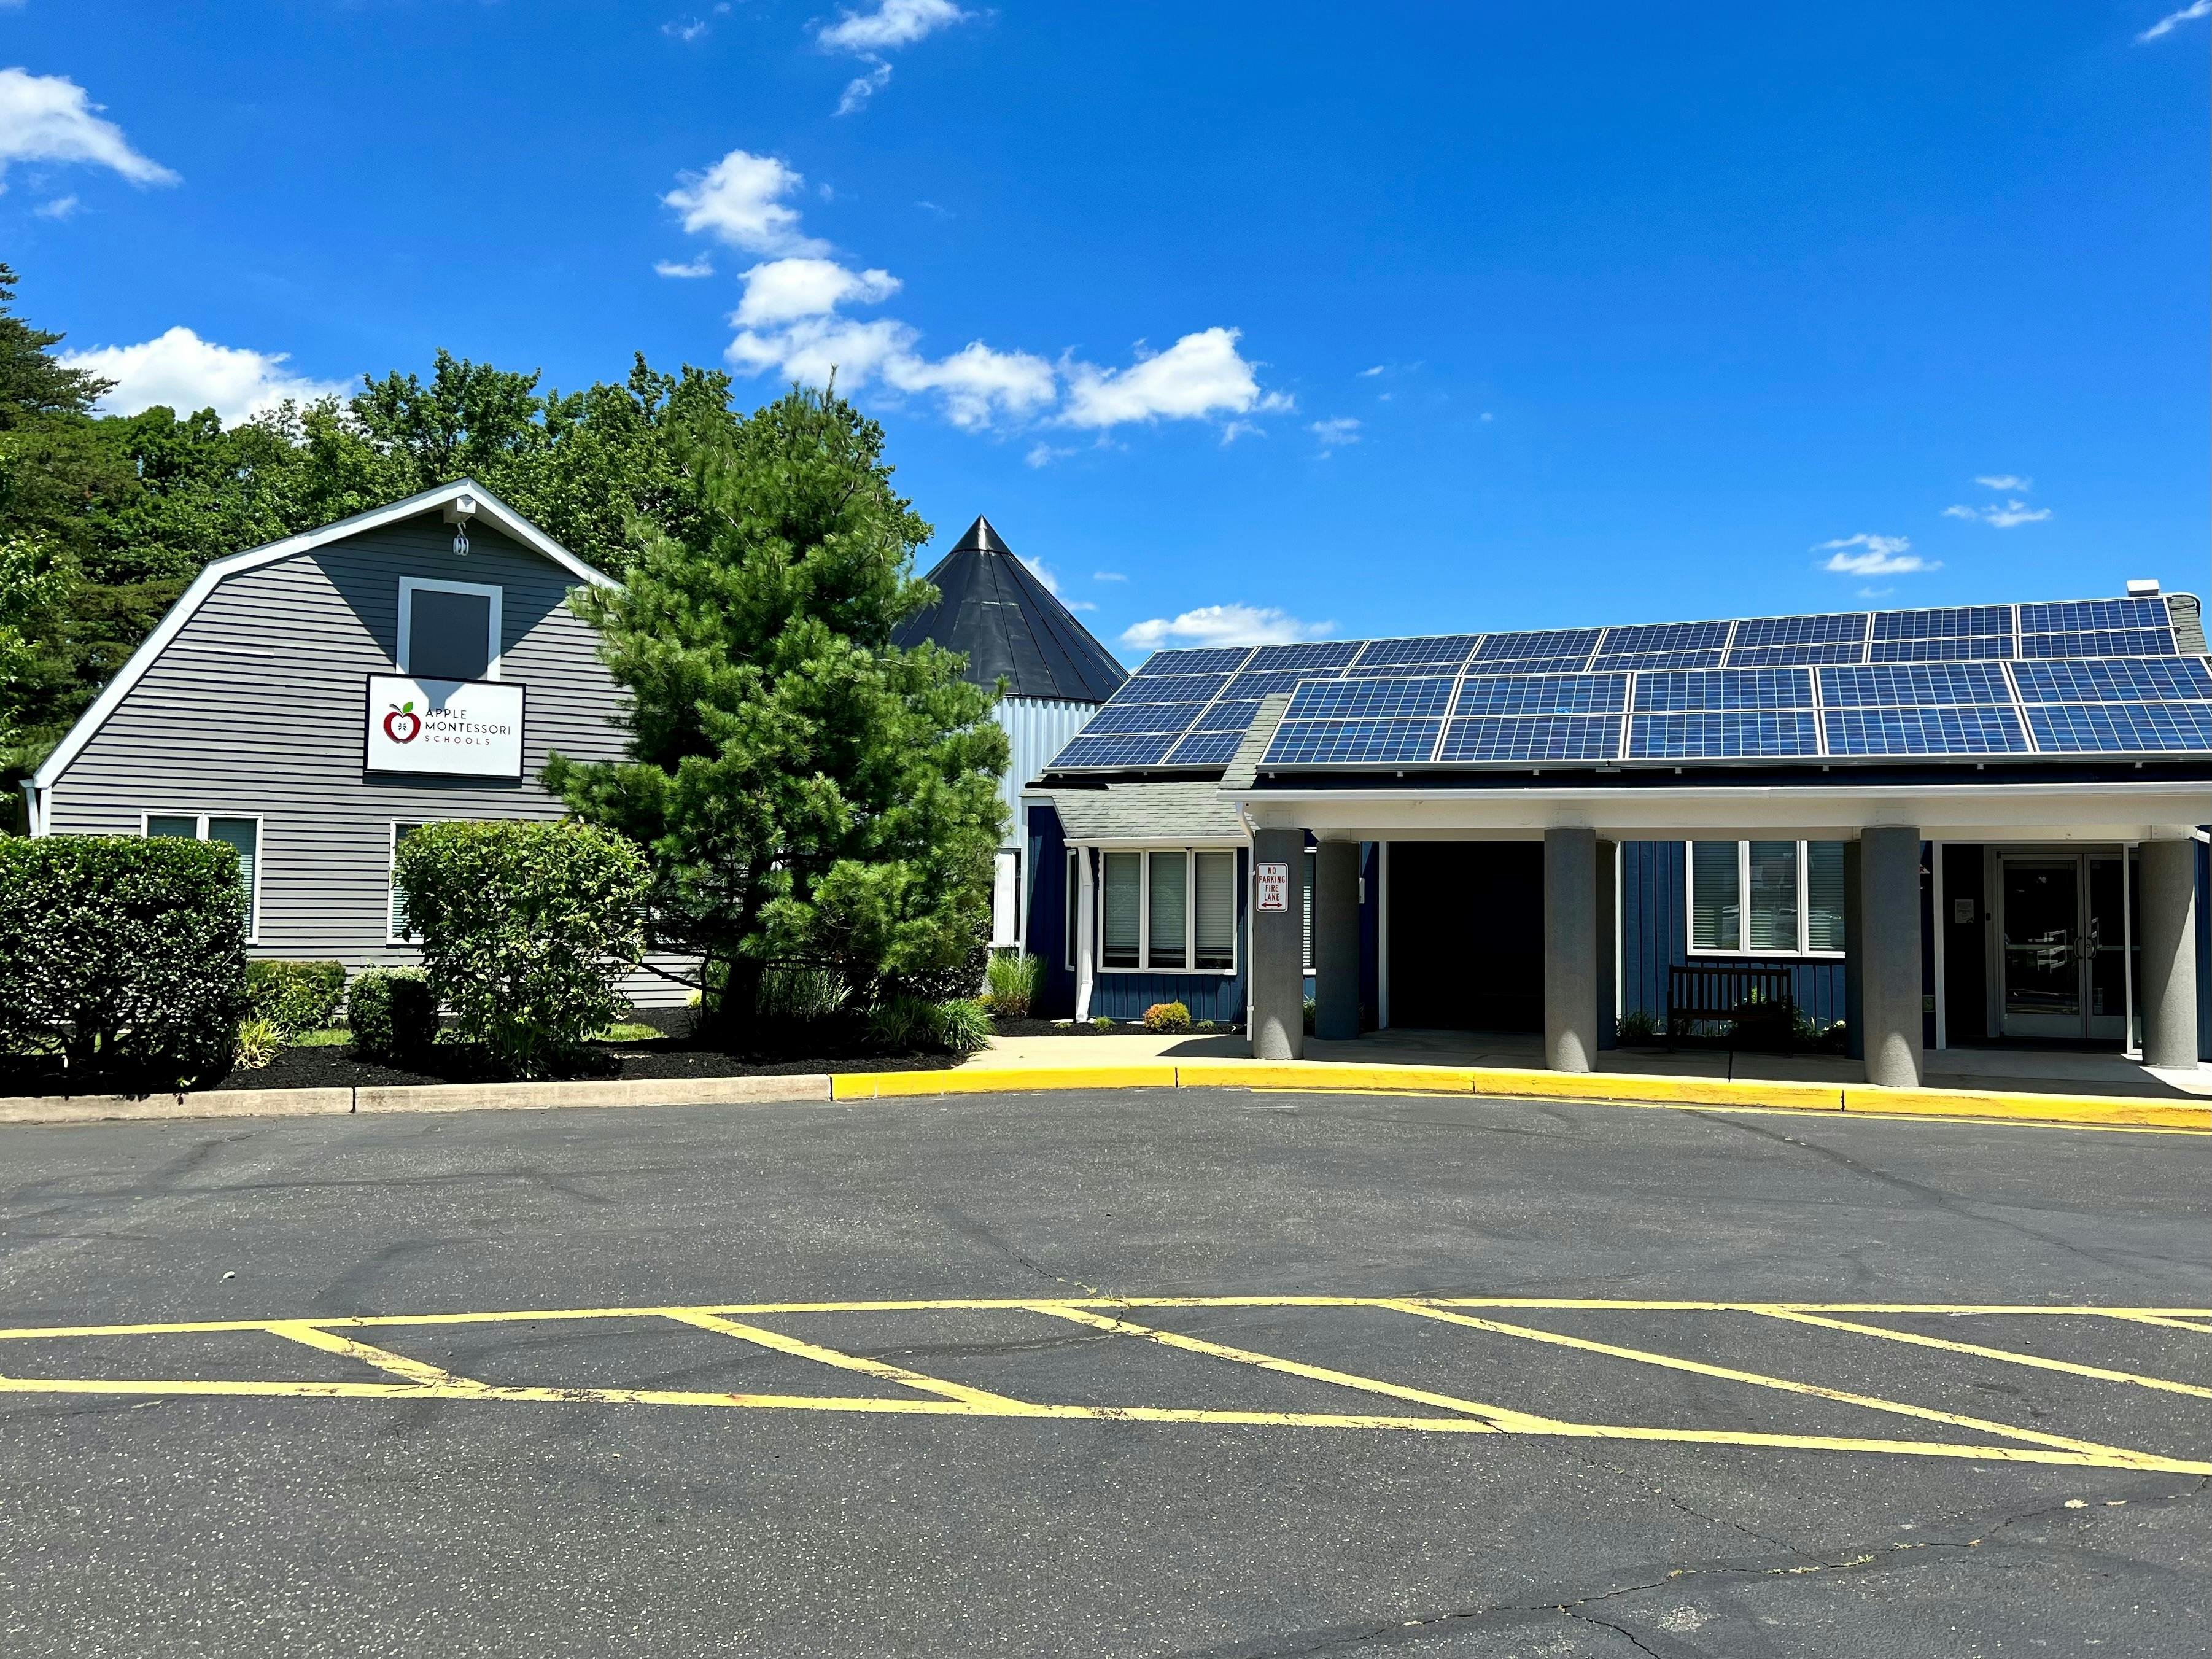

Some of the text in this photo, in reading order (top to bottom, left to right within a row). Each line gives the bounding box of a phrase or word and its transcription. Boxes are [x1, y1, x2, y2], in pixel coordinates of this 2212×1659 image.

[425, 708, 467, 720] APPLE
[425, 721, 511, 736] MONTESSORI
[424, 735, 490, 745] SCHOOLS
[1268, 866, 1276, 875] NO
